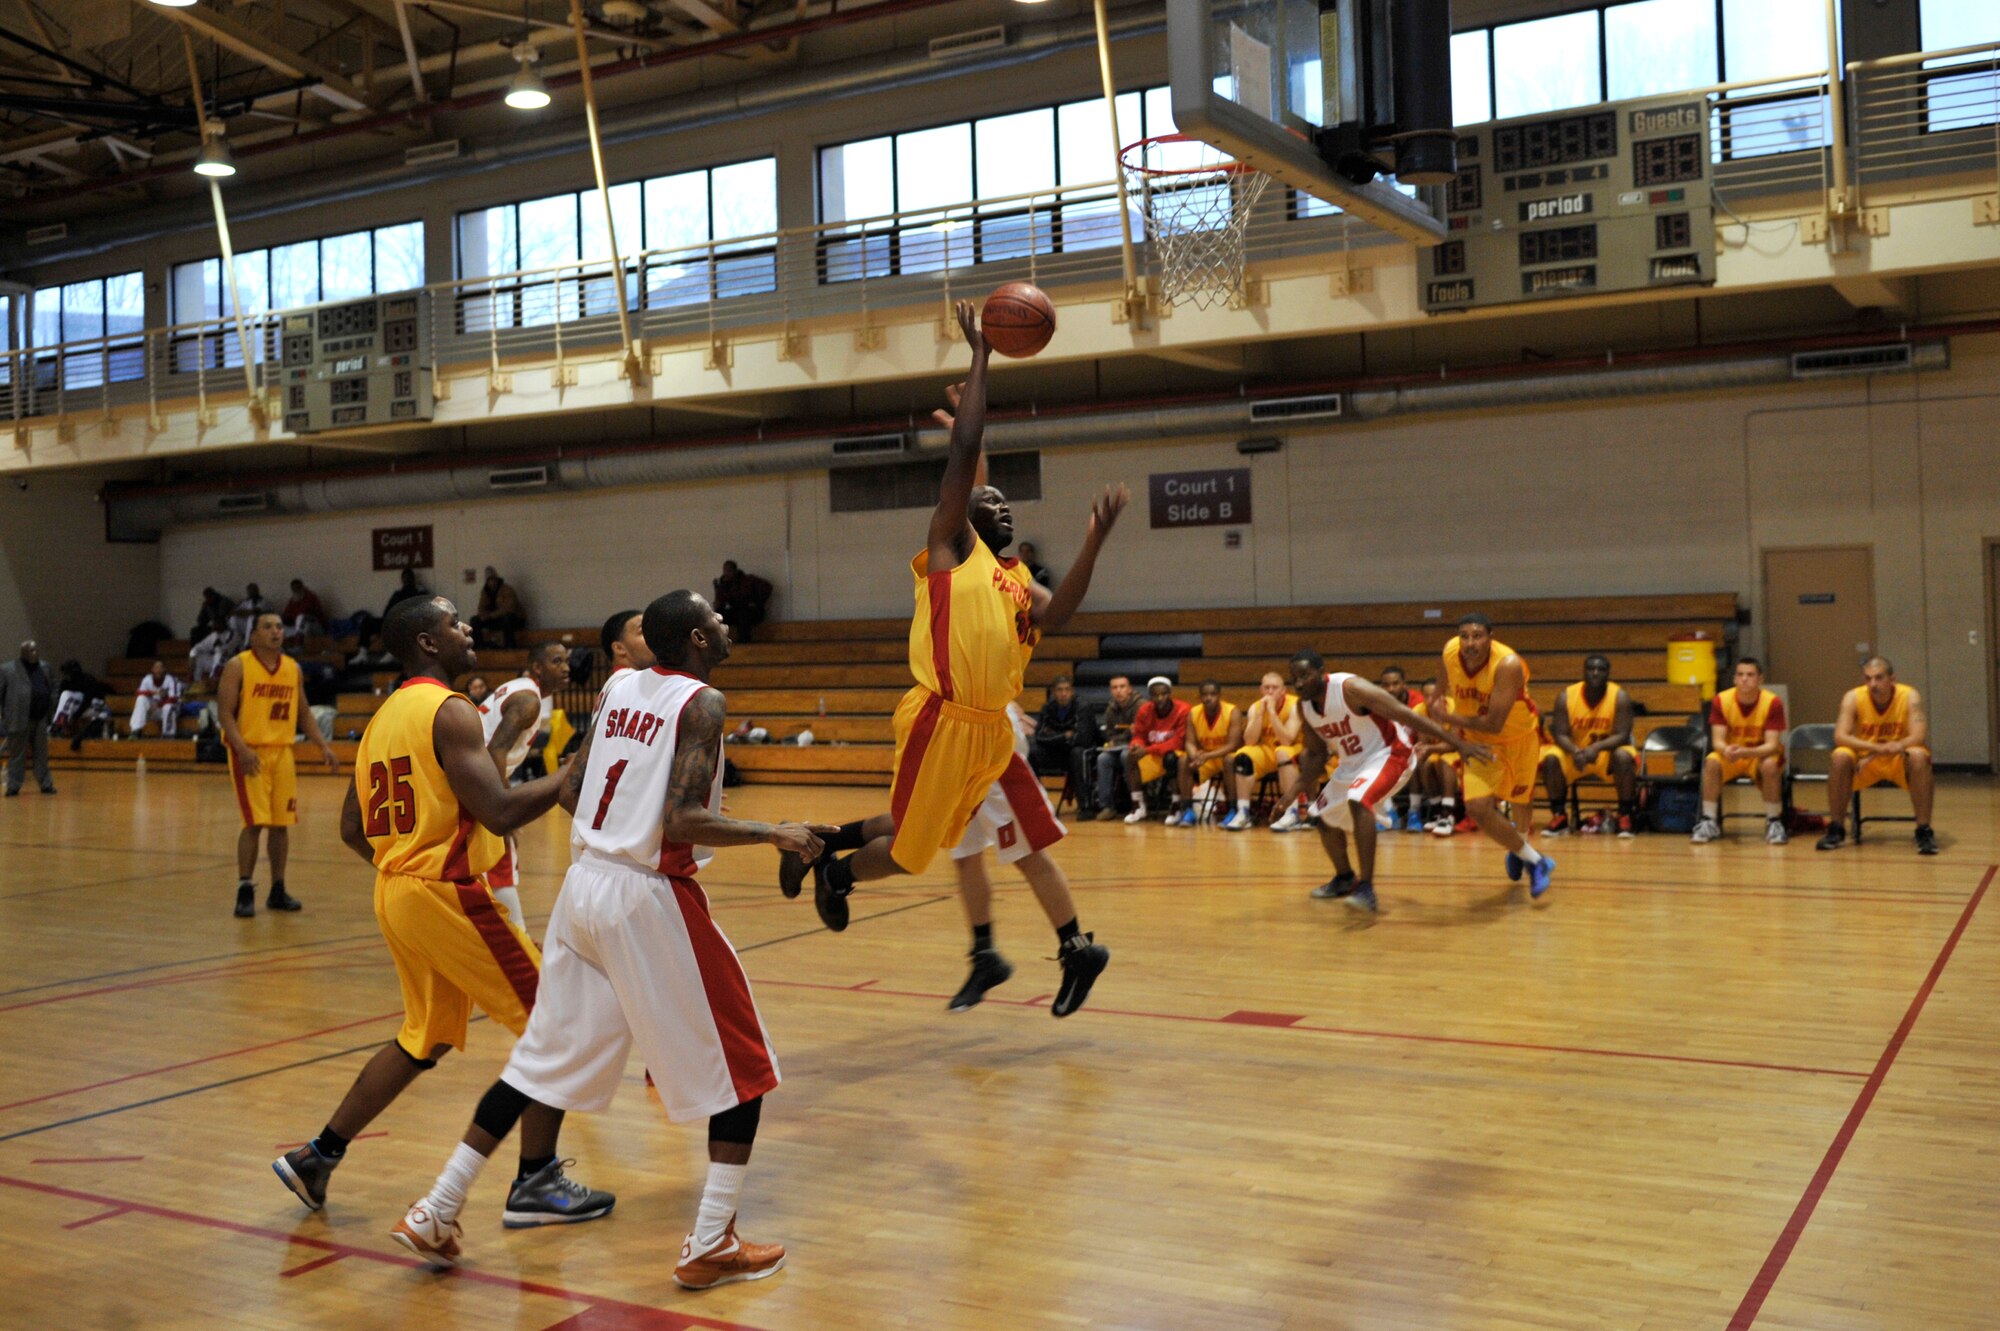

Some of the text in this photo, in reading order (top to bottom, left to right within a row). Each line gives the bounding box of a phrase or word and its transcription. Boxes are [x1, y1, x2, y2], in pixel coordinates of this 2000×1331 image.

[1634, 109, 1697, 132] Guests
[1527, 194, 1584, 222] period
[1431, 280, 1469, 301] fouls
[335, 356, 364, 375] period
[1164, 476, 1235, 496] Court 1
[1167, 502, 1233, 521] Side B
[380, 531, 413, 546] Court
[604, 708, 666, 747] SMART
[1340, 735, 1363, 757] 12
[366, 755, 416, 838] 25
[591, 759, 629, 830] 1
